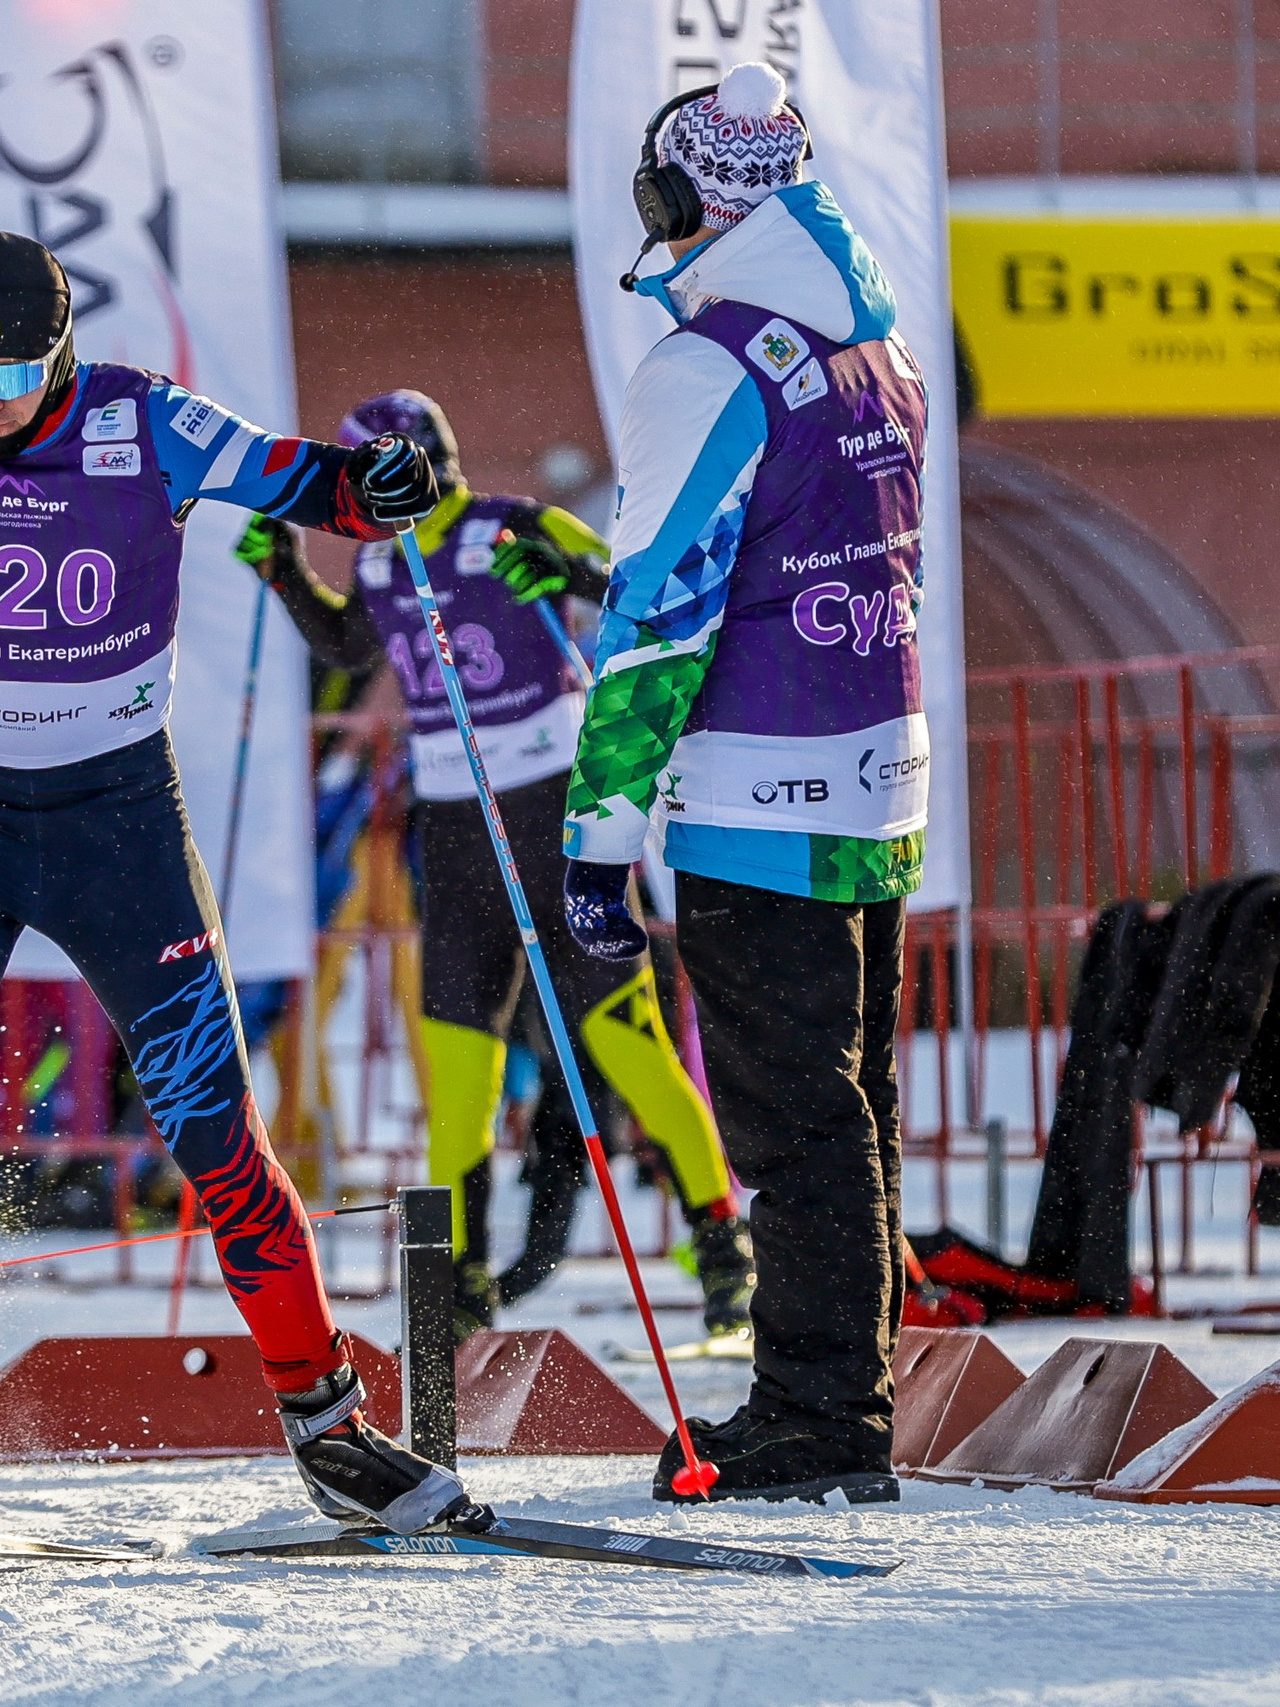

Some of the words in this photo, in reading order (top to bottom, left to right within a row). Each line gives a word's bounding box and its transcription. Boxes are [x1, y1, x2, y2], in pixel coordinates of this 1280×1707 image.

[837, 435, 865, 458] Тур
[867, 430, 883, 451] де
[2, 496, 22, 508] де
[27, 497, 69, 512] Бург
[782, 551, 842, 574] Кубок
[845, 540, 887, 562] Главы
[8, 622, 151, 662] Екатеринбурга
[752, 778, 829, 804] ОТВ
